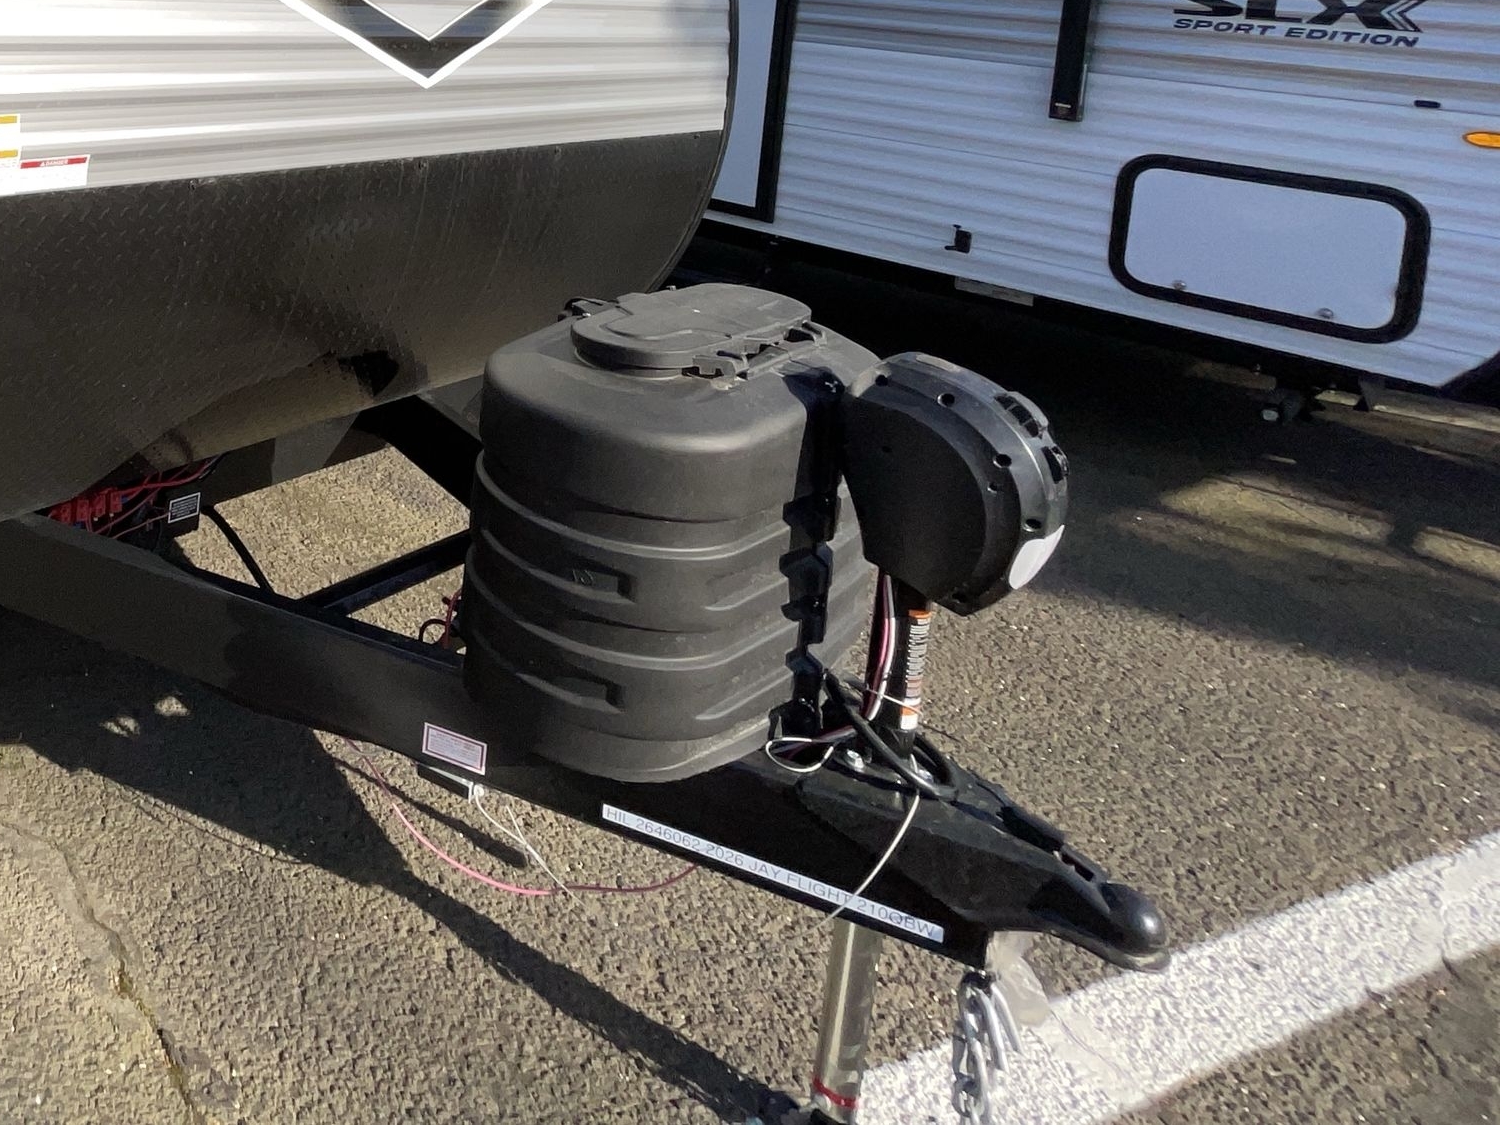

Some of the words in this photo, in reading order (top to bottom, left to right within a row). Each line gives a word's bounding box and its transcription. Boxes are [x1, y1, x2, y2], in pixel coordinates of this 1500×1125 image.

[1173, 18, 1276, 36] SPORT
[1284, 27, 1419, 48] EDITION
[606, 806, 631, 826] HIL
[635, 818, 701, 851] 2646062
[706, 842, 744, 866] 2026
[749, 861, 781, 879] JAY
[786, 873, 854, 904] FLIGHT
[856, 899, 935, 937] 210QBW
